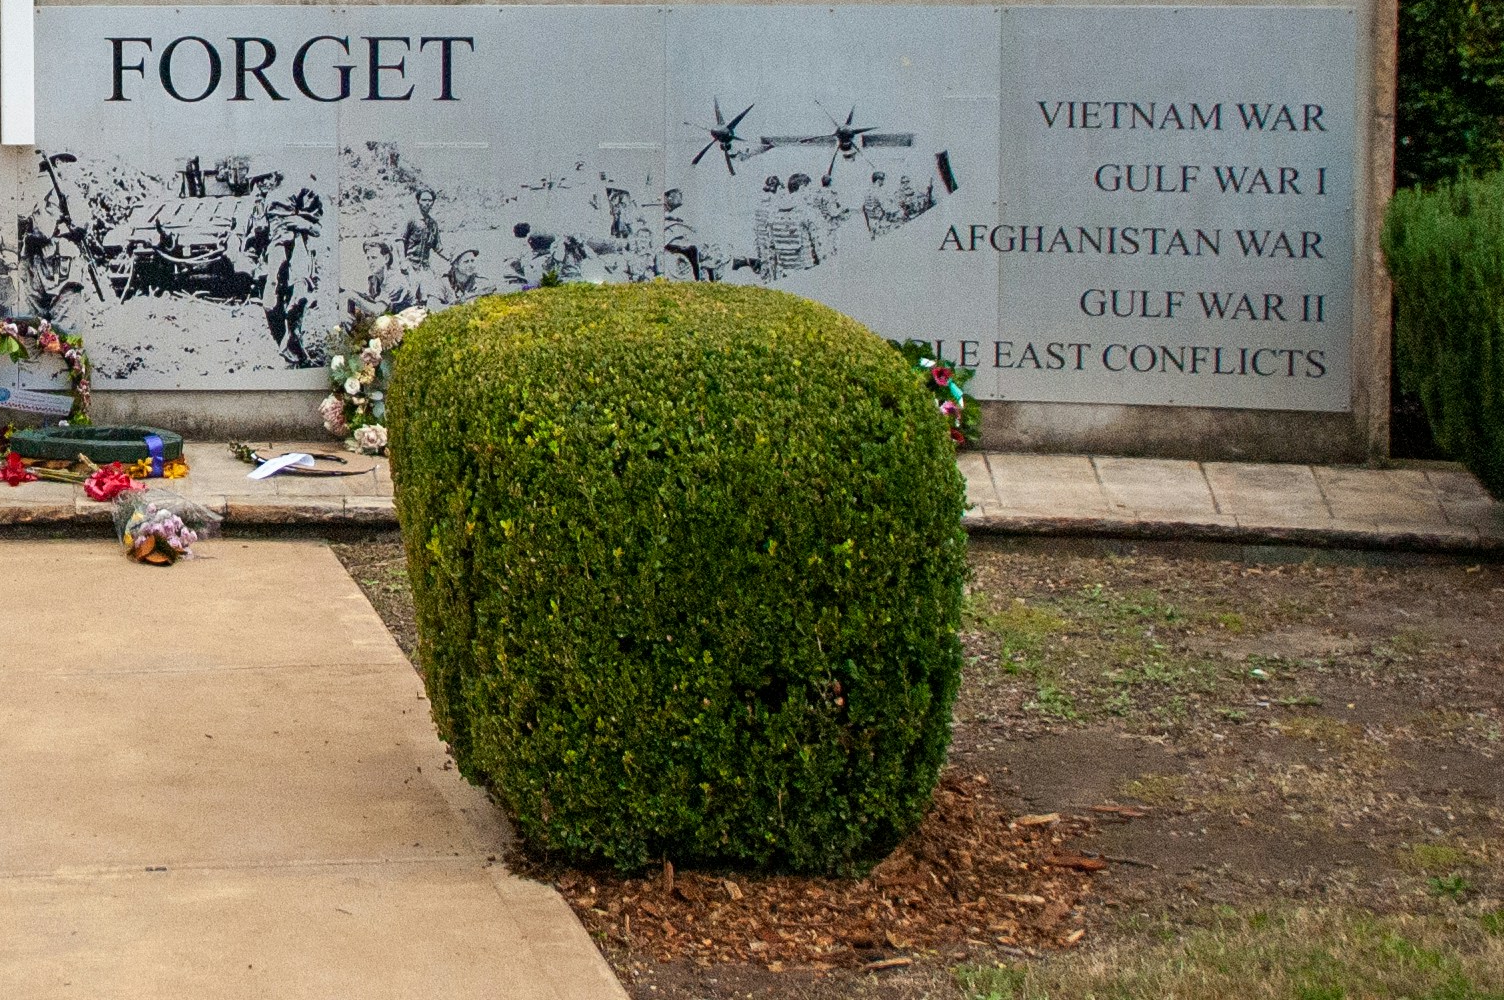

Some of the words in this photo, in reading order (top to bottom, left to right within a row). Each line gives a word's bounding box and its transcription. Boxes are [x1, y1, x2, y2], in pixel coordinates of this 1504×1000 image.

[104, 34, 476, 104] FORGET
[1037, 101, 1223, 131] VIETNAM
[1236, 103, 1326, 132] WAR
[1094, 164, 1200, 193] GULF
[1213, 166, 1302, 195] WAR
[1316, 167, 1327, 196] I
[938, 224, 1222, 256] AFGHANISTAN
[1235, 229, 1324, 259] WAR
[1079, 288, 1185, 319] GULF
[1197, 292, 1287, 322] WAR
[1301, 294, 1325, 323] II
[993, 340, 1092, 371] EAST
[1101, 343, 1327, 378] CONFLICTS
